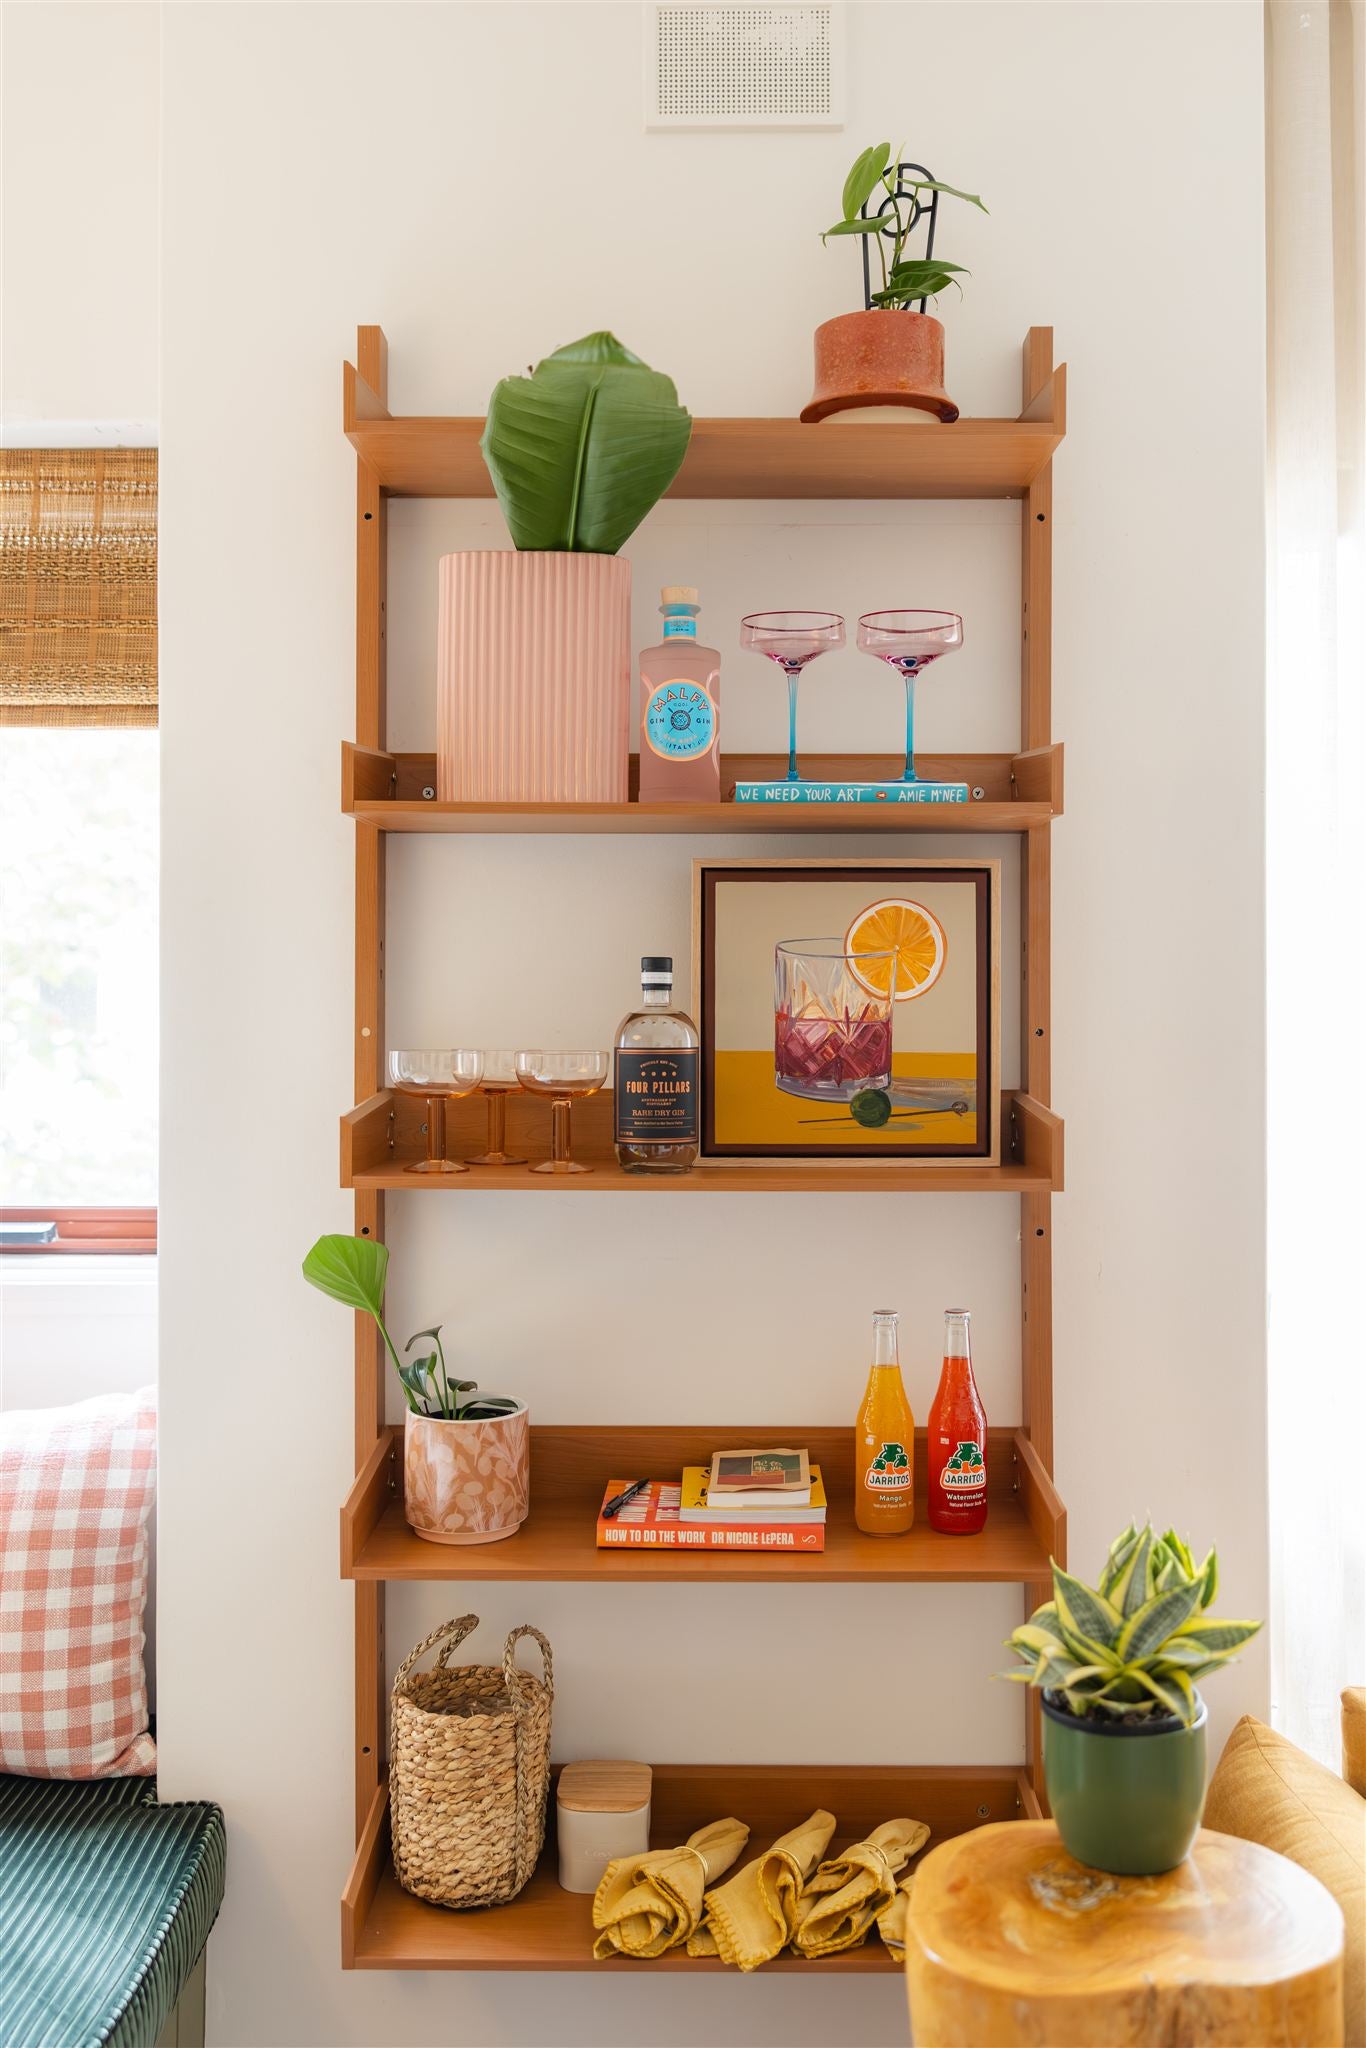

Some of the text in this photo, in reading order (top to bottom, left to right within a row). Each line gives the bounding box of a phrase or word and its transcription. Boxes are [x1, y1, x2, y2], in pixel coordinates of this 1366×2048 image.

[653, 688, 709, 712] MALFY
[740, 788, 872, 802] WE NEED YOUR ART
[898, 789, 926, 802] AMIE
[626, 1081, 690, 1094] FOUR PILLARS
[870, 1474, 909, 1486] JARRITOS
[945, 1473, 984, 1484] JARRITOS
[605, 1529, 705, 1543] HOW TO DO THE WORK
[711, 1531, 724, 1544] DR
[726, 1532, 759, 1544] NICOLE
